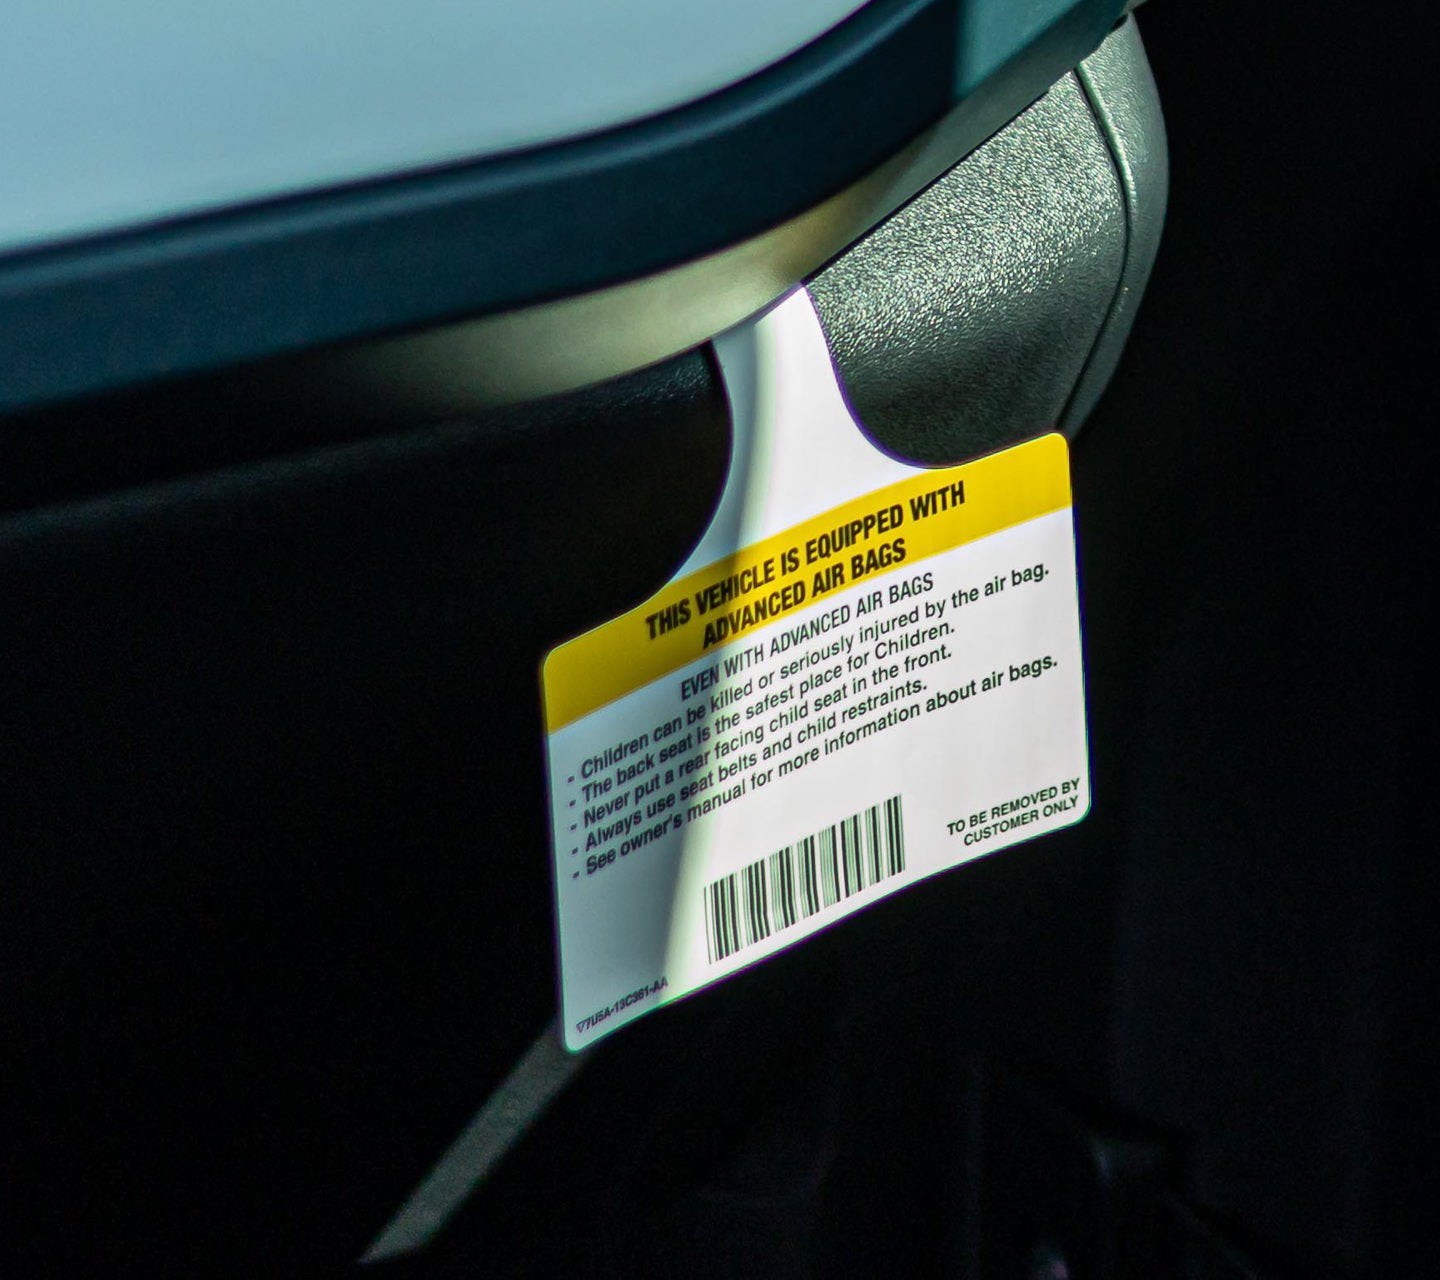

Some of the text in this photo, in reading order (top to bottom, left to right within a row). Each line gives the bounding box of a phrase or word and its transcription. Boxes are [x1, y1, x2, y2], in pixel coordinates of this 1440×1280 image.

[645, 480, 965, 640] THIS VEHICLE IS EQUIPPED WITH
[681, 572, 933, 700] EVEN WITH ADVANCED AIR BAGS
[703, 538, 906, 649] ADVANCED AIR BAGS
[581, 563, 1049, 779] Children can be killed or seriously injured by the air bag.
[582, 622, 956, 802] The back seat is the safest place for Children.
[584, 644, 952, 828] Never put a rear facing child seat in the front.
[585, 679, 927, 852] Always use seat belts and child restraints.
[586, 655, 1058, 875] See owner's manual for more information about air bags.
[946, 777, 1080, 836] TO BE REMOVED BY
[963, 795, 1078, 846] CUSTOMER ONLY
